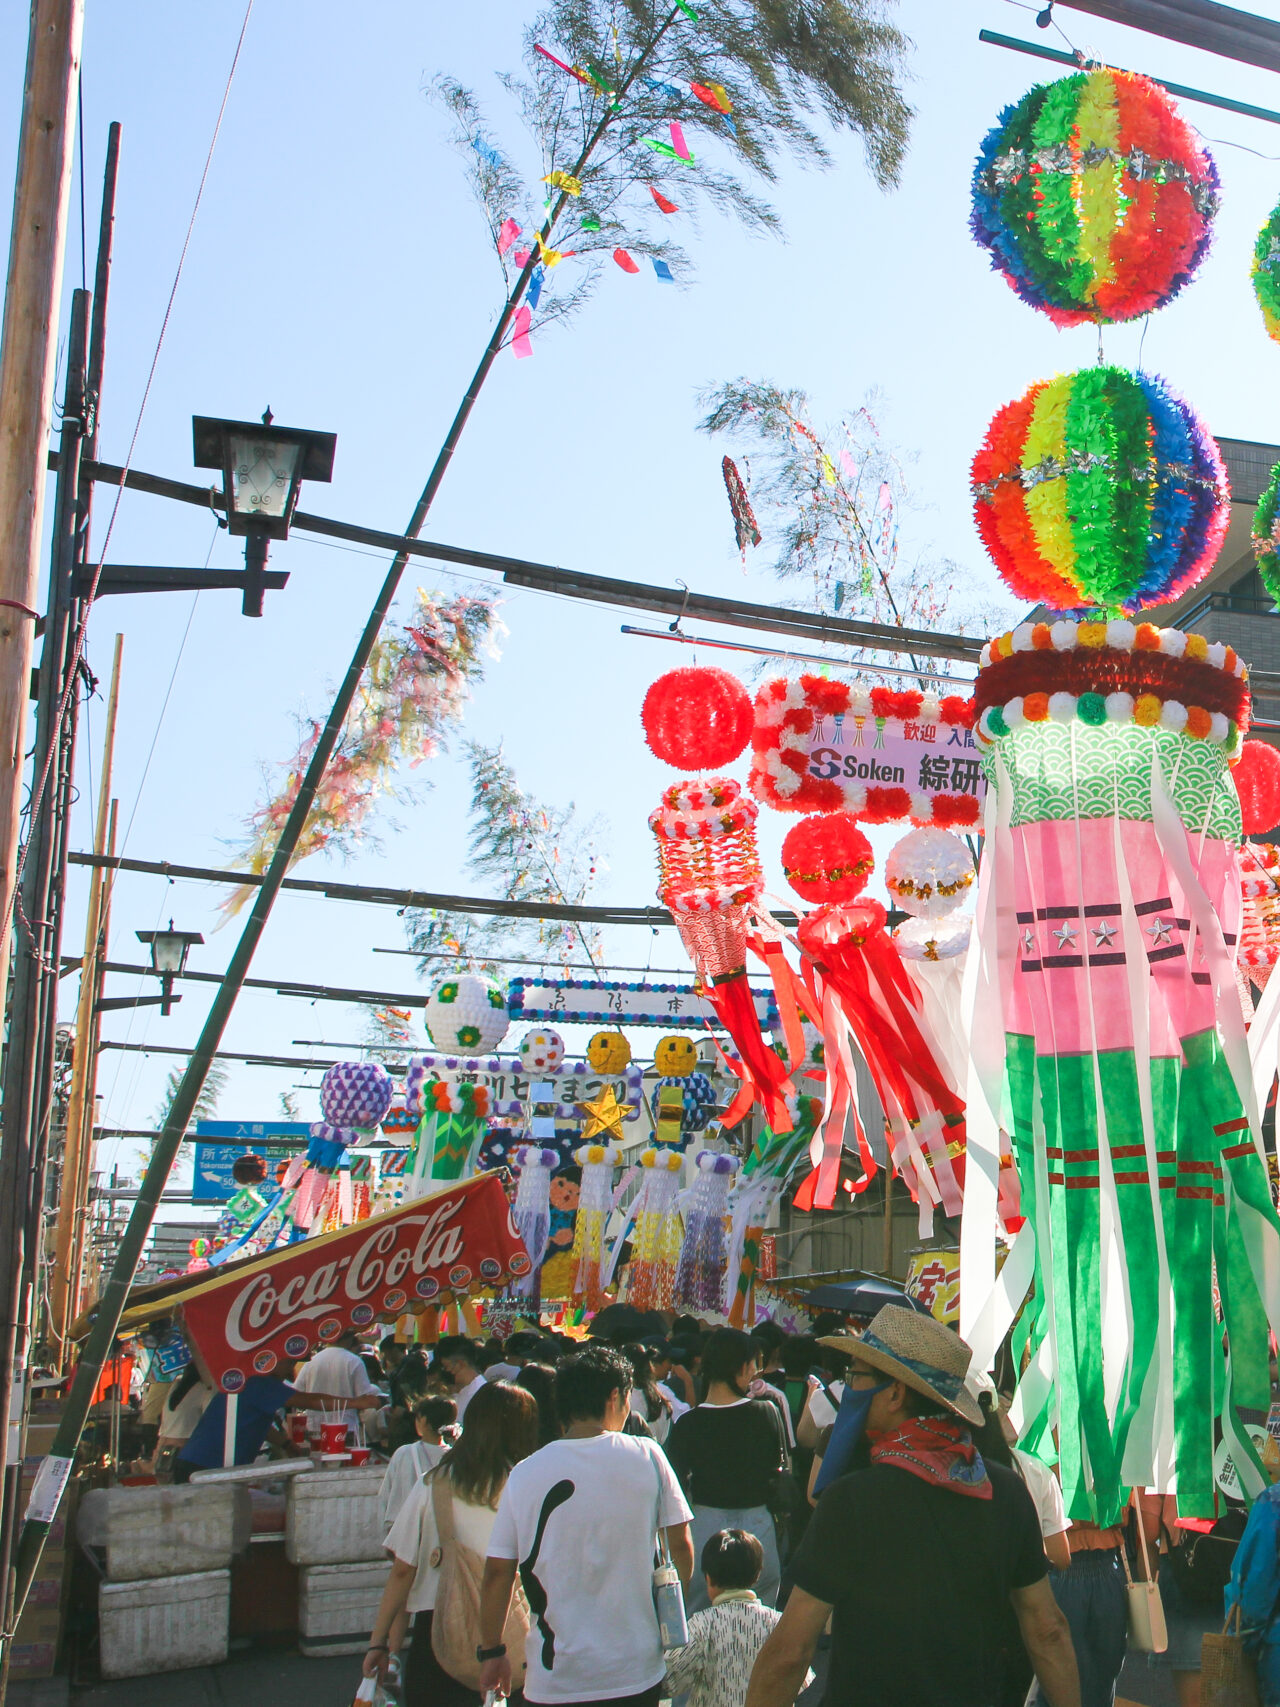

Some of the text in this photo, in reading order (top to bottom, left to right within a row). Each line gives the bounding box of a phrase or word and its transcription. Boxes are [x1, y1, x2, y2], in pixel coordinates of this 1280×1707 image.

[903, 721, 936, 743] 歓迎
[842, 755, 905, 783] Soken
[236, 1125, 264, 1135] 入間
[200, 1162, 234, 1170] Tokorozaw
[223, 1178, 234, 1187] 50
[225, 1196, 467, 1351] Coca-Cola
